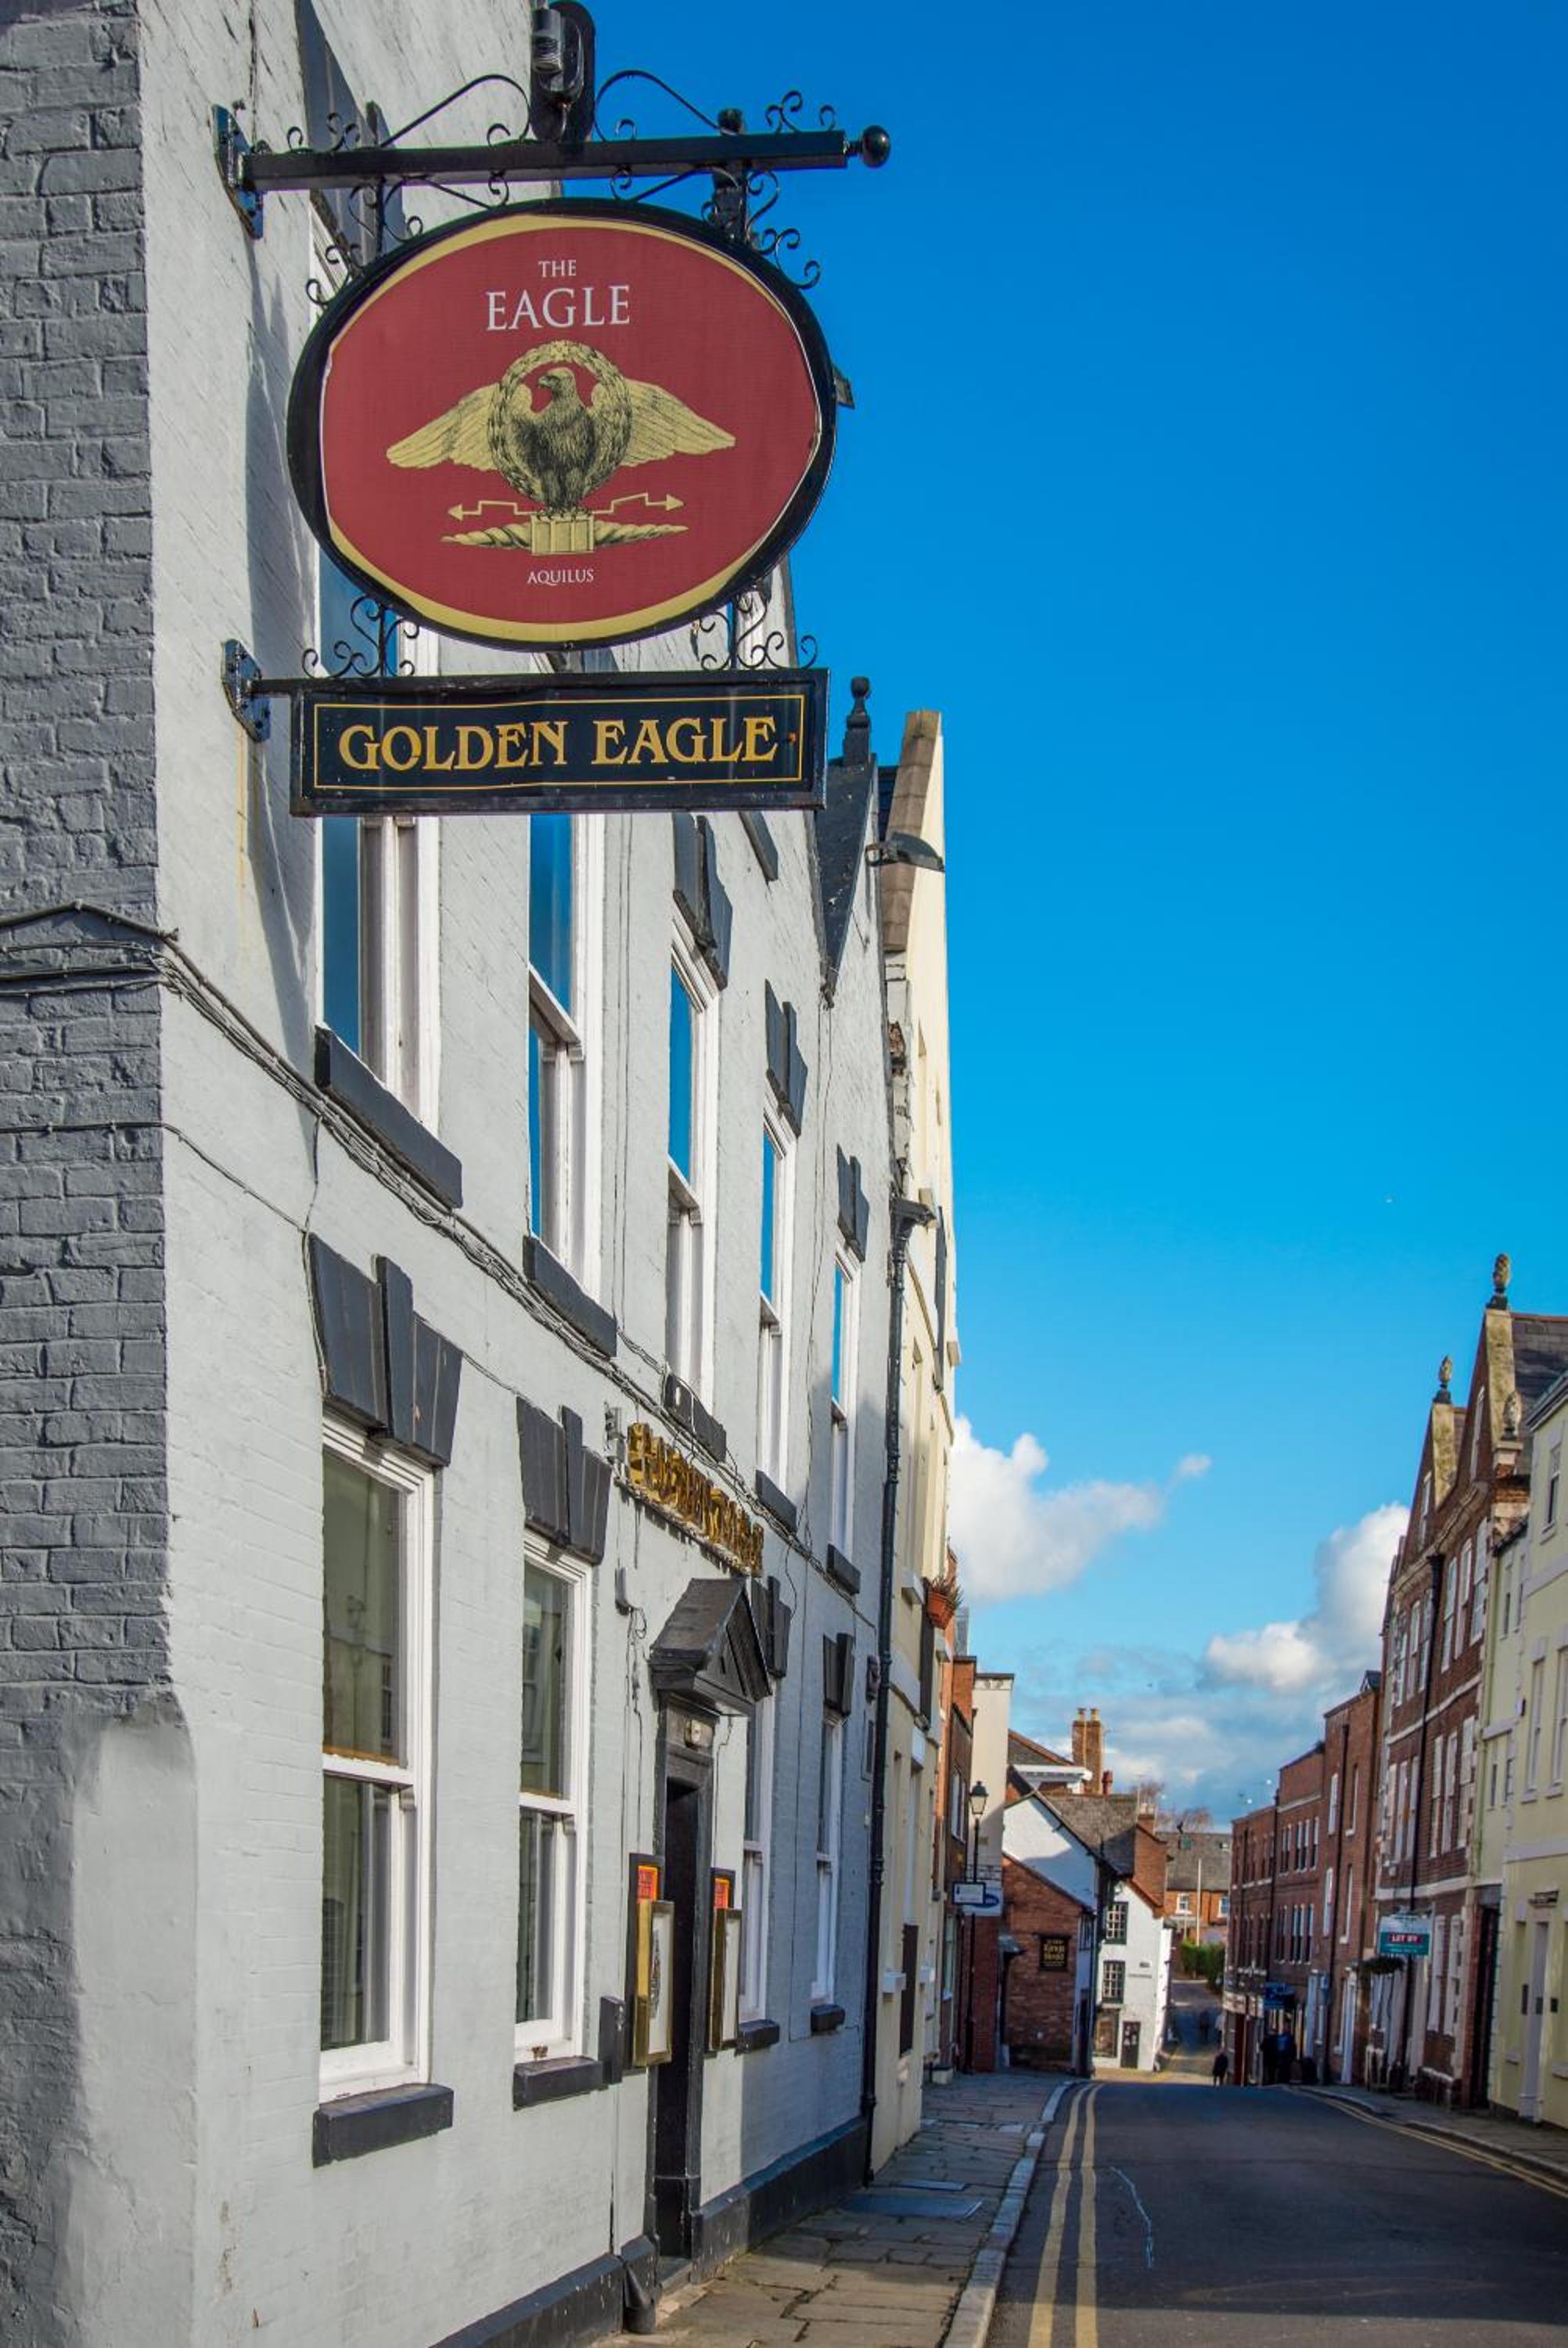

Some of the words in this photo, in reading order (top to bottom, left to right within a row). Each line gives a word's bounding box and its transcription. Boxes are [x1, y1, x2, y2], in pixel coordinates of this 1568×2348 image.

[538, 259, 577, 278] THE
[485, 284, 631, 332] EAGLE
[527, 568, 594, 586] AQUILUS
[338, 720, 570, 772] GOLDEN
[591, 715, 779, 765] EAGLE
